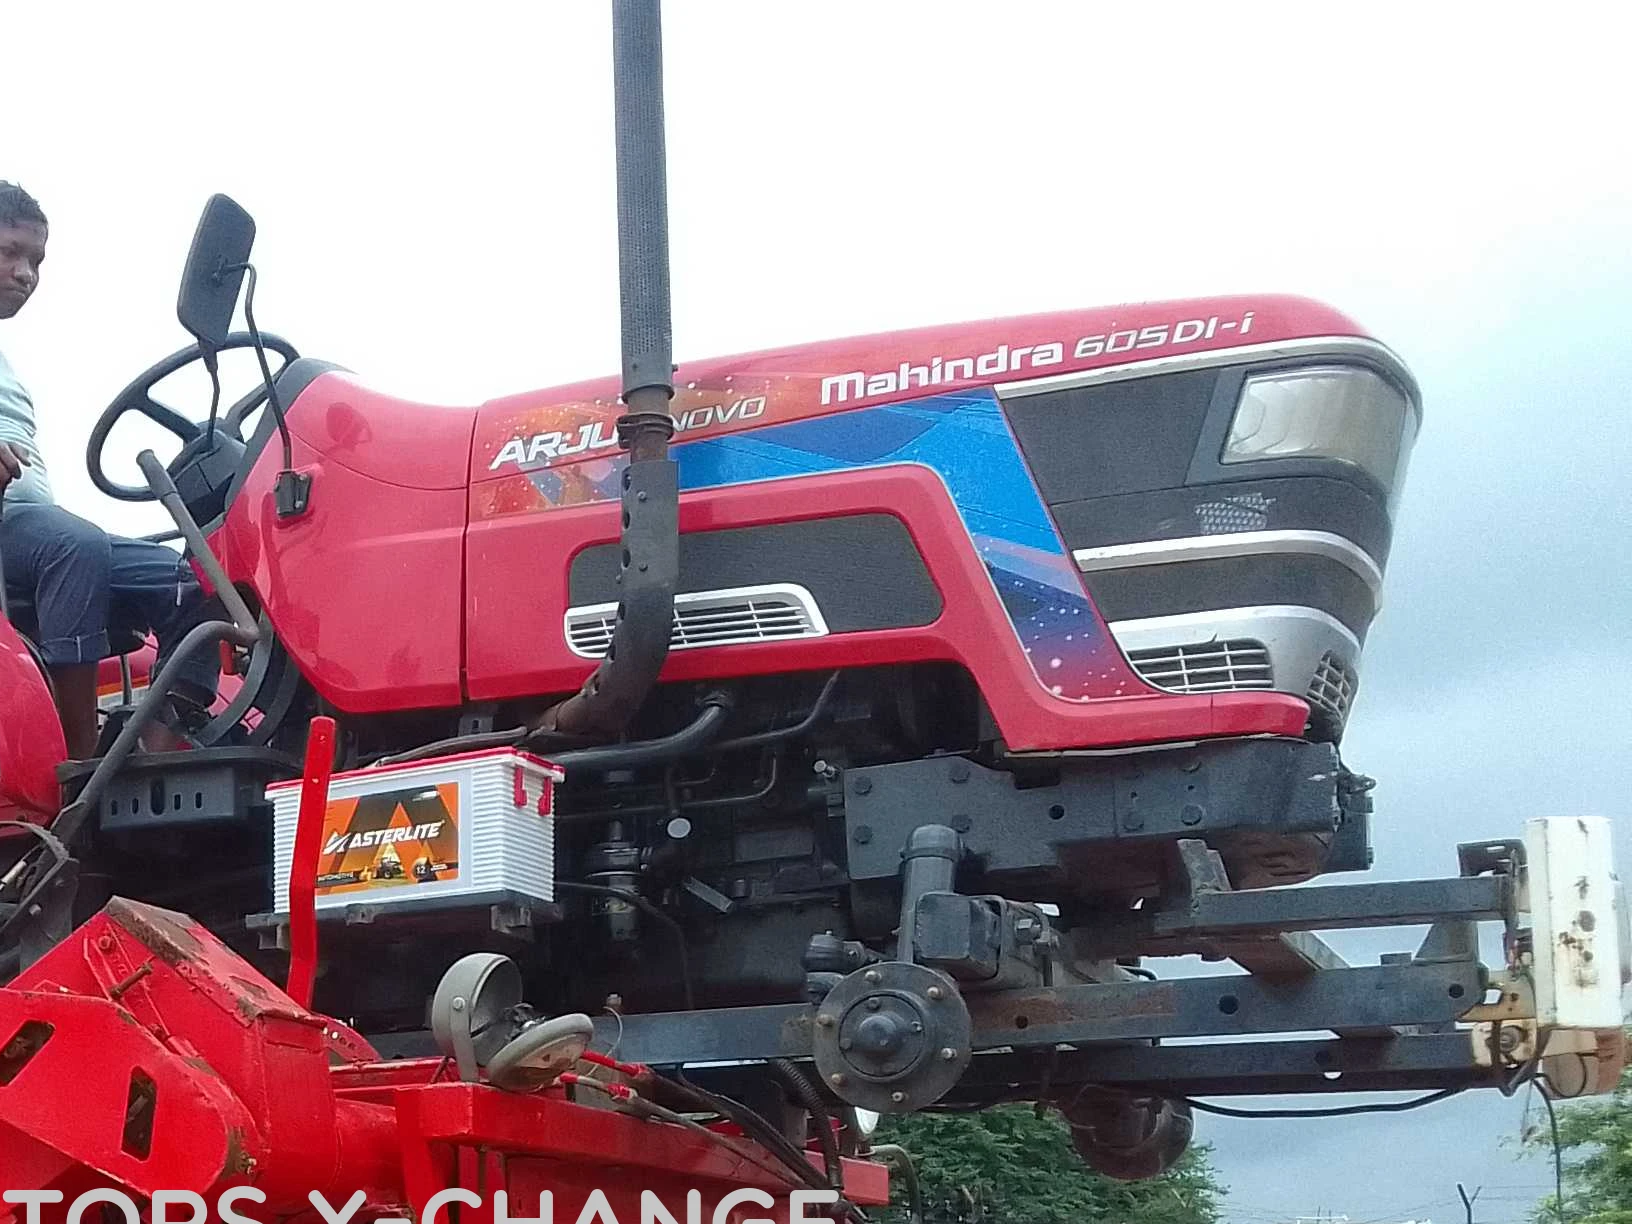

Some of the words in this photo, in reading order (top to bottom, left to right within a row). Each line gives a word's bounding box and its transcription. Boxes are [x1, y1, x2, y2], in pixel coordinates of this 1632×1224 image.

[820, 342, 1063, 405] Mahindra
[668, 396, 766, 434] NOVO
[349, 822, 442, 849] ASTERLITE
